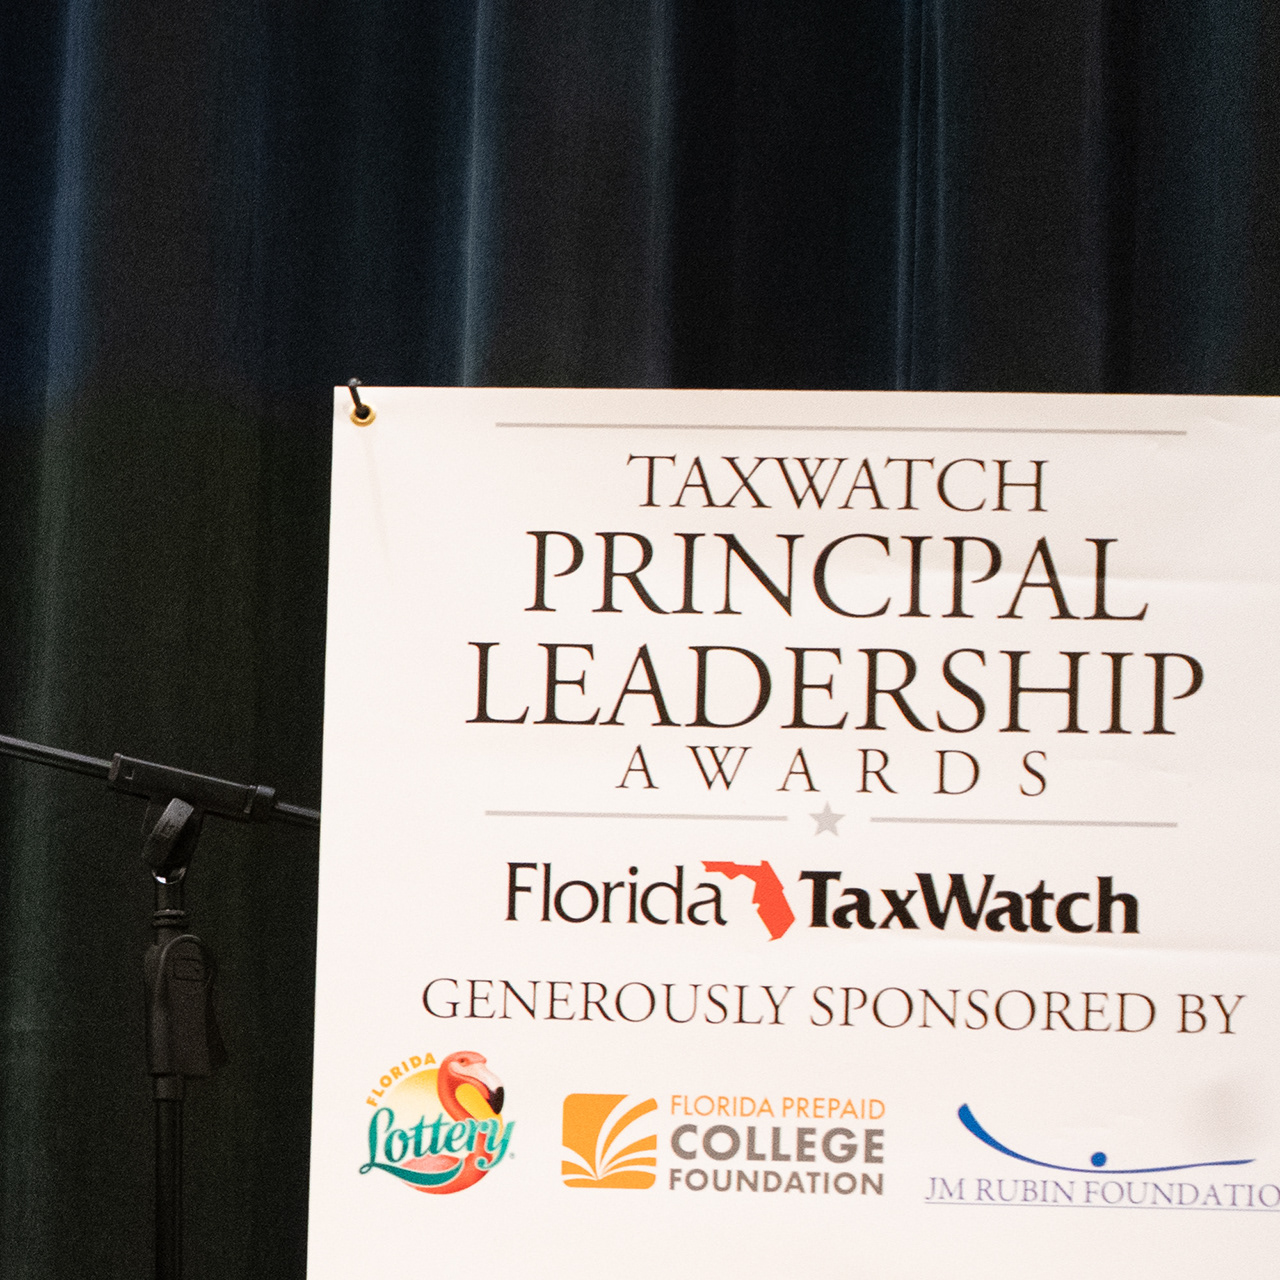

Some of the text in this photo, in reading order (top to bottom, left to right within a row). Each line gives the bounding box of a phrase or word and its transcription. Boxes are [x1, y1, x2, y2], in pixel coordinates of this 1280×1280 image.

[627, 453, 1050, 511] TAXWATCH
[525, 529, 1149, 621] PRINCIPAL
[466, 641, 1205, 736] LEADERSHIP
[616, 744, 1050, 796] AWARDS
[505, 861, 1141, 935] Florida TaxWatch
[421, 977, 1247, 1035] GENEROUSLY SPONSORED BY
[365, 1051, 438, 1107] FLORIDA
[670, 1094, 886, 1120] FLORIDA PREPAID
[359, 1106, 517, 1185] Lottery
[671, 1123, 885, 1165] COLLEGE
[669, 1167, 885, 1195] FOUNDATION
[925, 1176, 965, 1201] JM
[976, 1179, 1074, 1202] RUBIN
